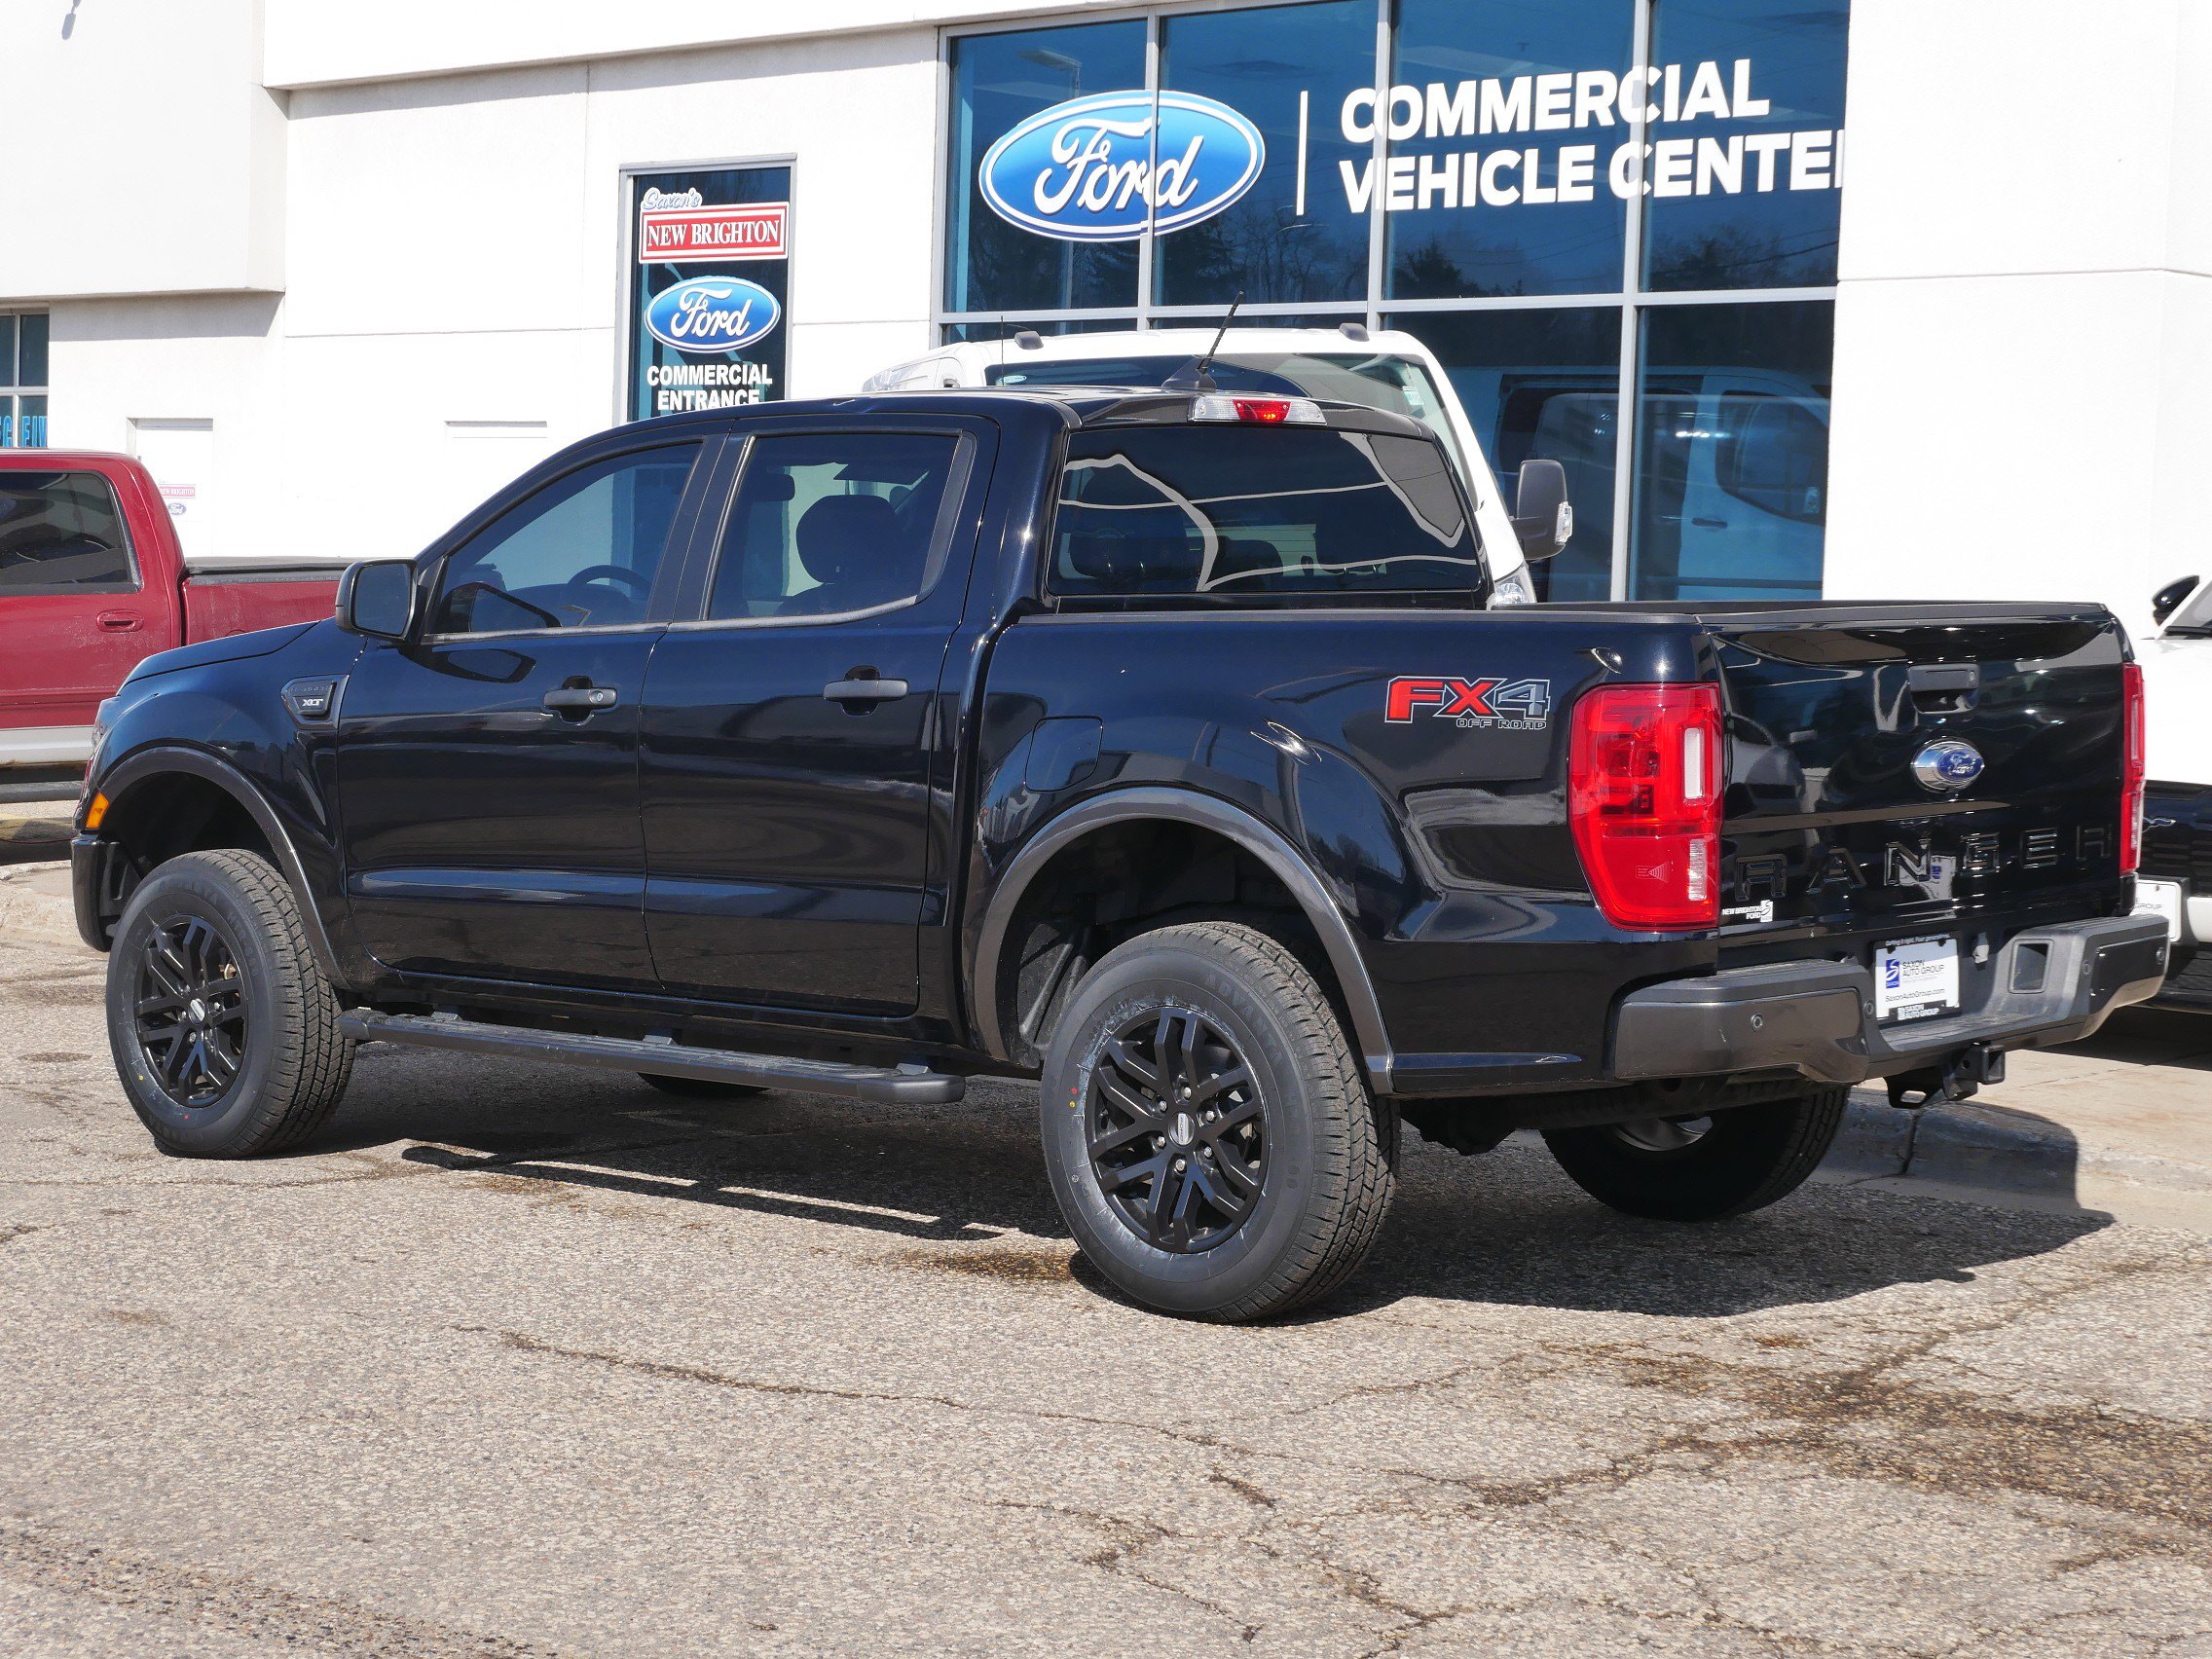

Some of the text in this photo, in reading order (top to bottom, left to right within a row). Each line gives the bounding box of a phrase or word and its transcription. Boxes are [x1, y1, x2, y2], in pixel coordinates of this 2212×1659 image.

[1341, 58, 1769, 143] COMMERCIAL
[1033, 116, 1204, 215] Ford
[1339, 144, 1596, 213] VEHICLE
[642, 188, 701, 210] Saxon's
[647, 219, 780, 246] NEW BRIGHTON
[670, 287, 753, 338] Ford
[646, 363, 773, 387] COMMERCIAL
[657, 388, 760, 411] ENTRANCE
[301, 698, 324, 707] XLT
[1384, 676, 1550, 723] FX4
[1456, 718, 1547, 730] OFF ROAD
[1733, 824, 2113, 902] RANGER
[1901, 959, 1925, 970] SAXON
[1902, 965, 1944, 977] AUTO GROUP
[1885, 988, 1945, 1003] SaxonAutoGroup.com
